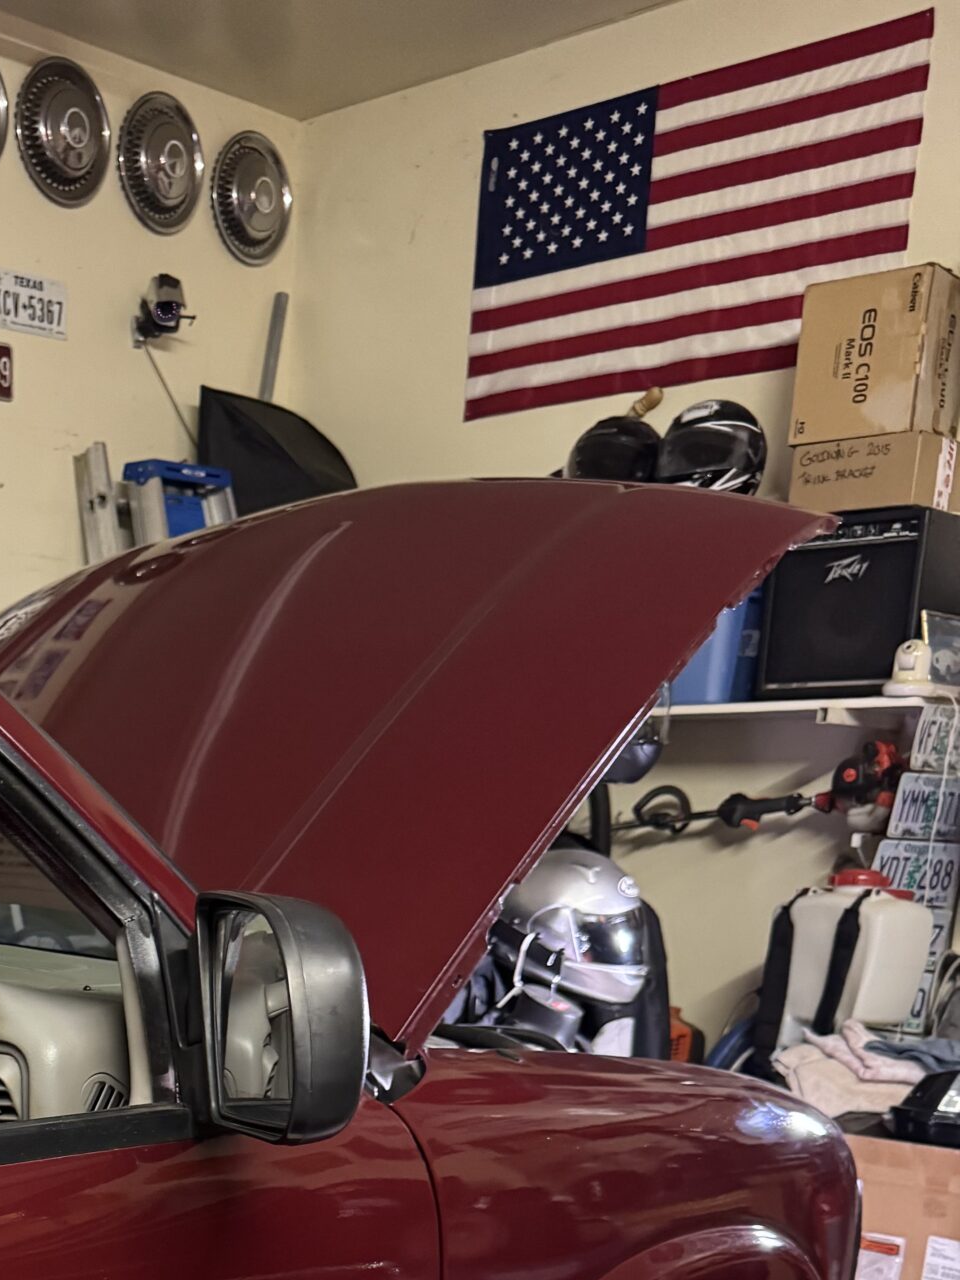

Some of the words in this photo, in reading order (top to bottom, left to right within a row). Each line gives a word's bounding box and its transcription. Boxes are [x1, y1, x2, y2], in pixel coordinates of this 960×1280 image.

[842, 338, 856, 370] Mark
[857, 307, 878, 358] EOS
[851, 362, 872, 405] C100
